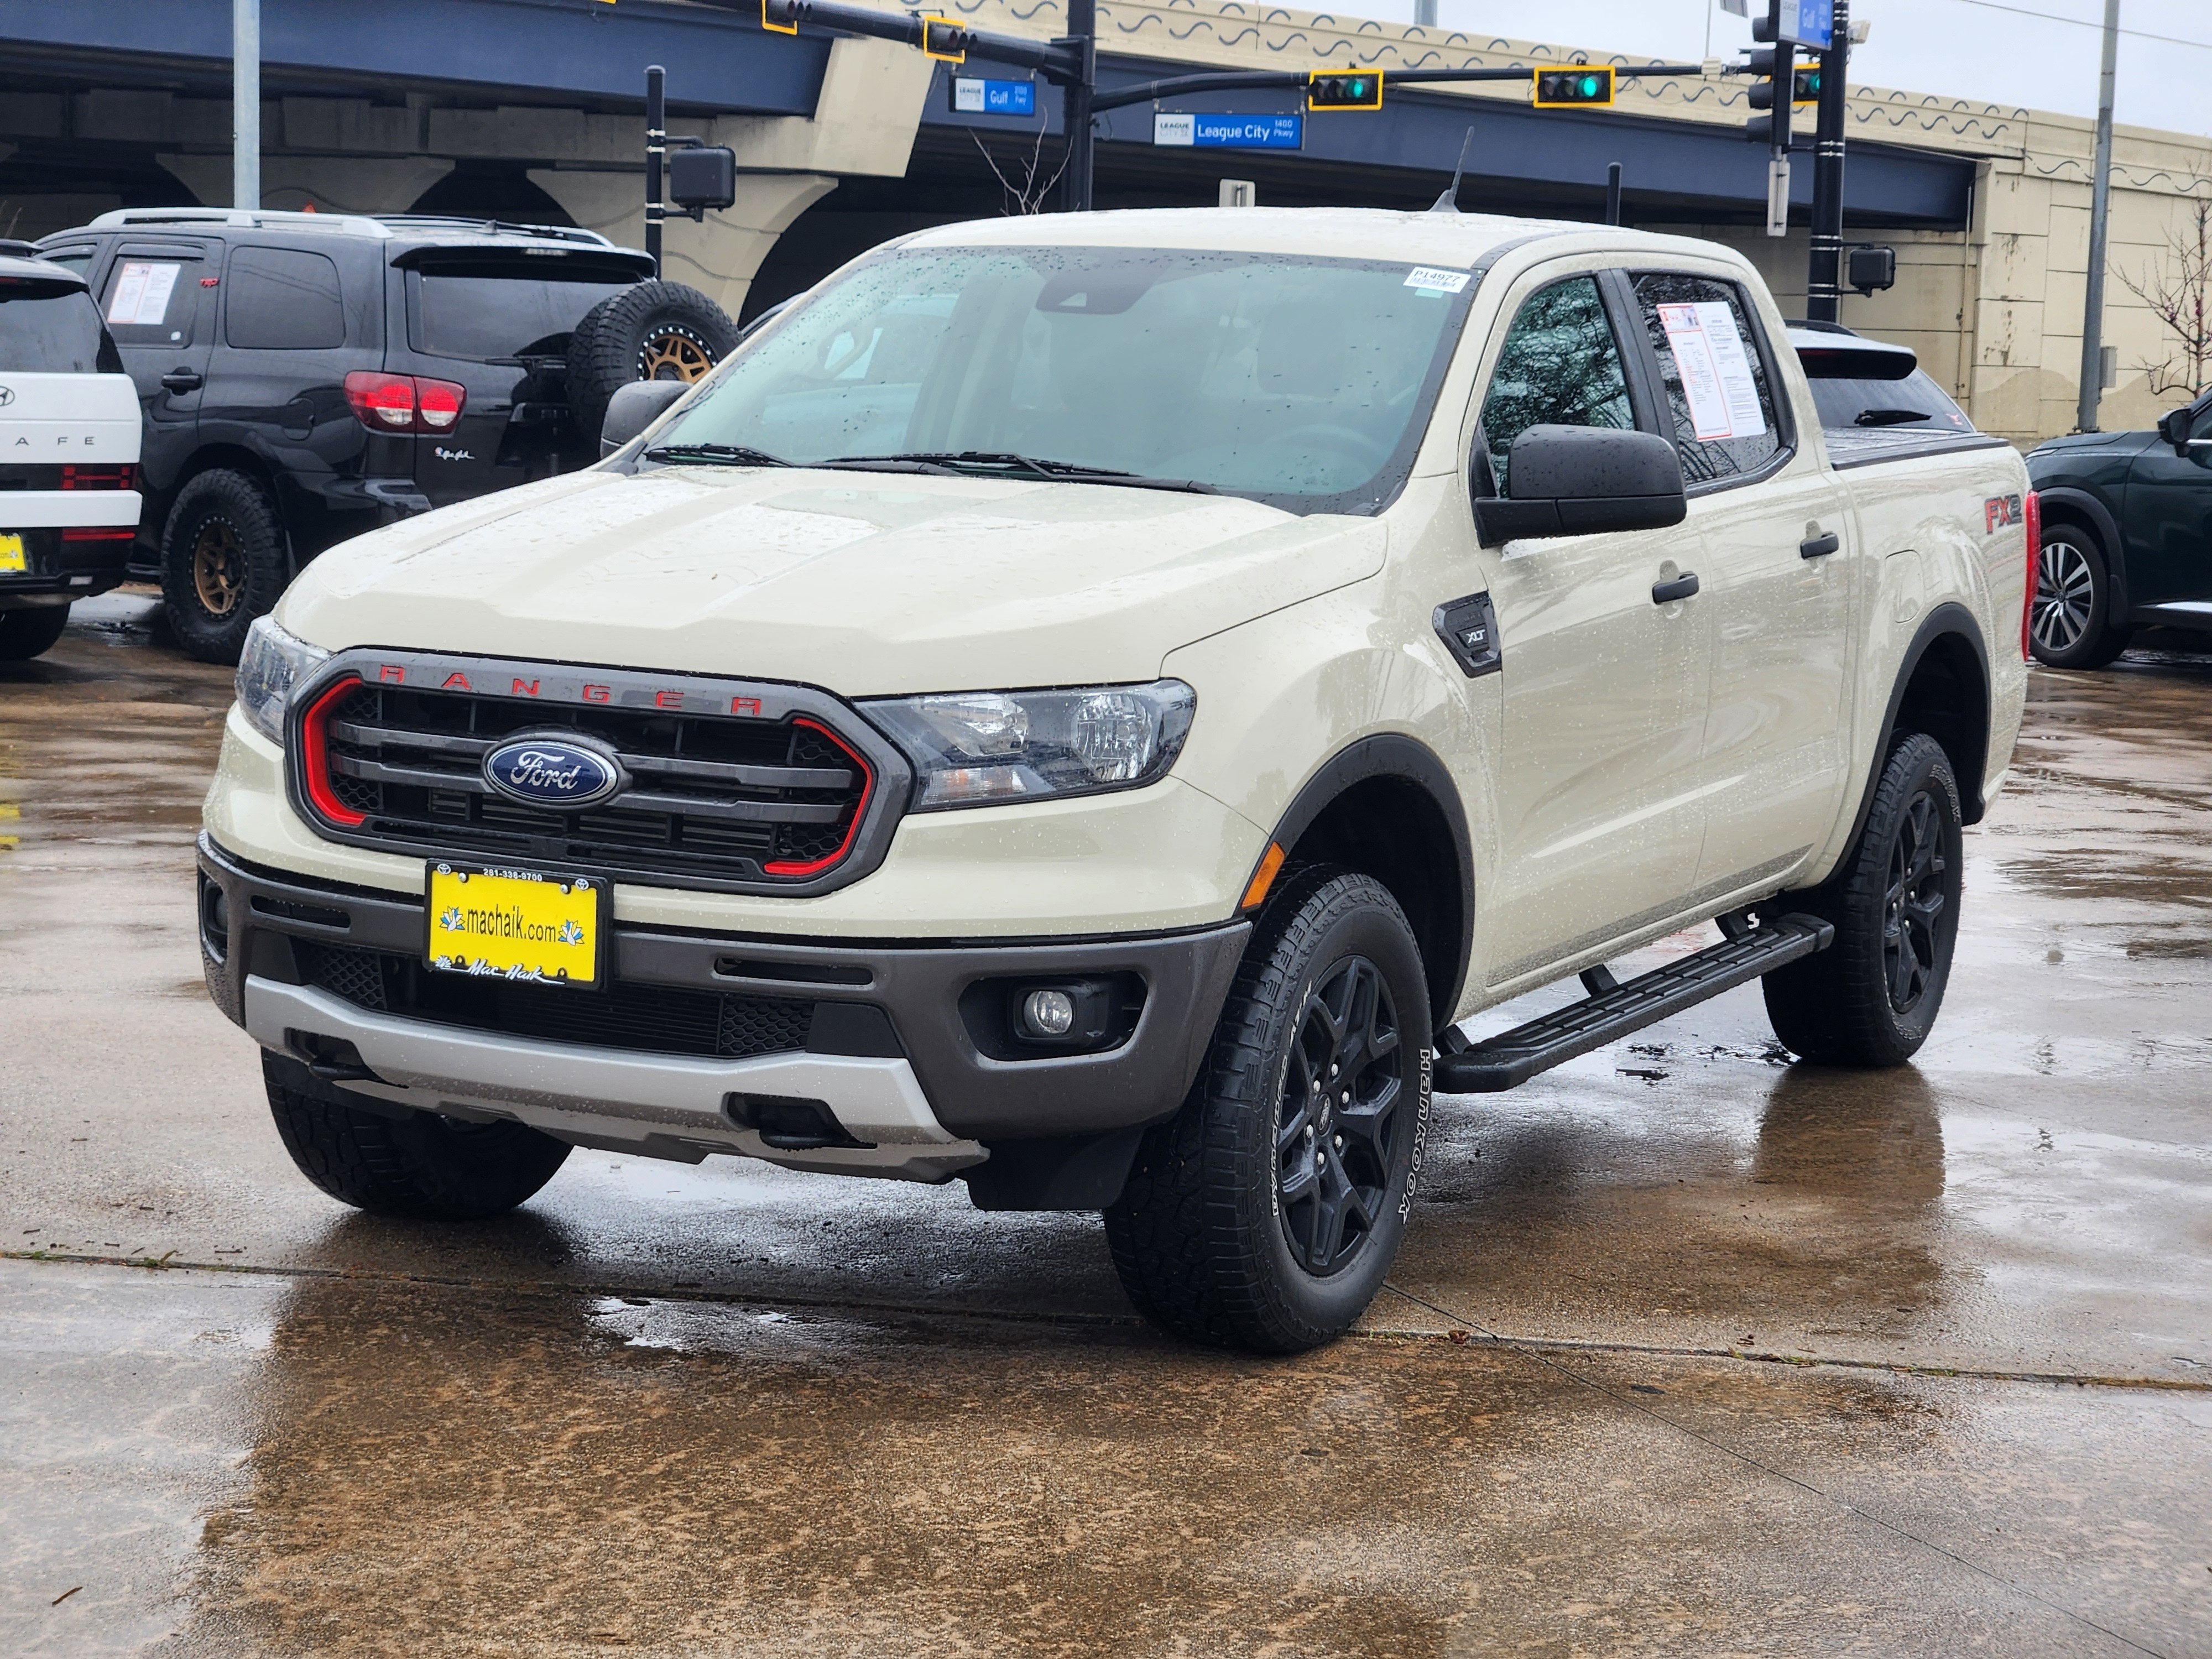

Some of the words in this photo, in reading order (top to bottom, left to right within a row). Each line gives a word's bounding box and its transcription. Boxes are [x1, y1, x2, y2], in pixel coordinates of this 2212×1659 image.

[990, 90, 1009, 105] Gulf
[1274, 119, 1293, 128] 1400
[1197, 123, 1243, 142] League
[1244, 123, 1270, 142] City
[1273, 128, 1294, 139] Pkwy
[1414, 270, 1460, 282] P14977
[1985, 493, 2022, 535] FX2
[1466, 629, 1486, 644] XLT
[380, 665, 762, 716] RANGER
[510, 750, 582, 790] Ford
[483, 868, 543, 881] 281-338-9700
[467, 904, 556, 943] machaik.com
[468, 958, 502, 976] Mac
